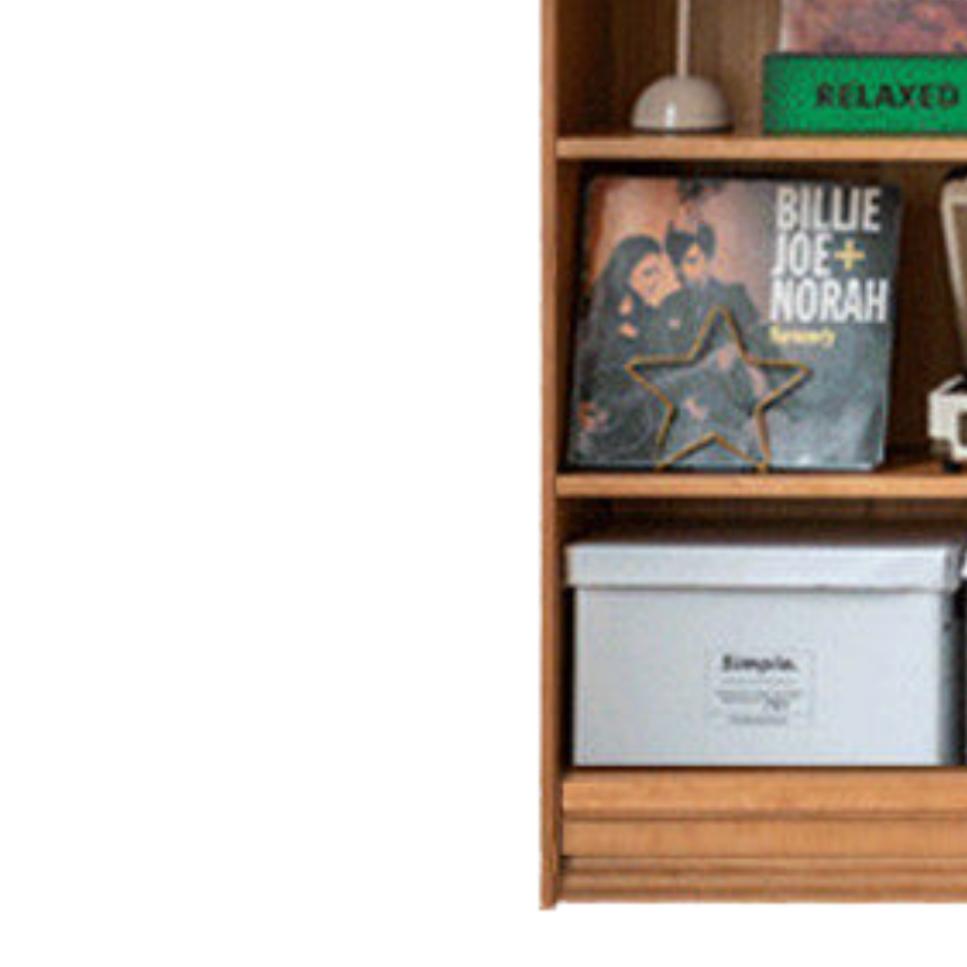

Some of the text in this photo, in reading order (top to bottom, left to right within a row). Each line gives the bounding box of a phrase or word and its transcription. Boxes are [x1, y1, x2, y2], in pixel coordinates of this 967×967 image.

[815, 83, 960, 110] RELAXED
[775, 185, 882, 232] BILLIE
[768, 277, 889, 323] NORAH
